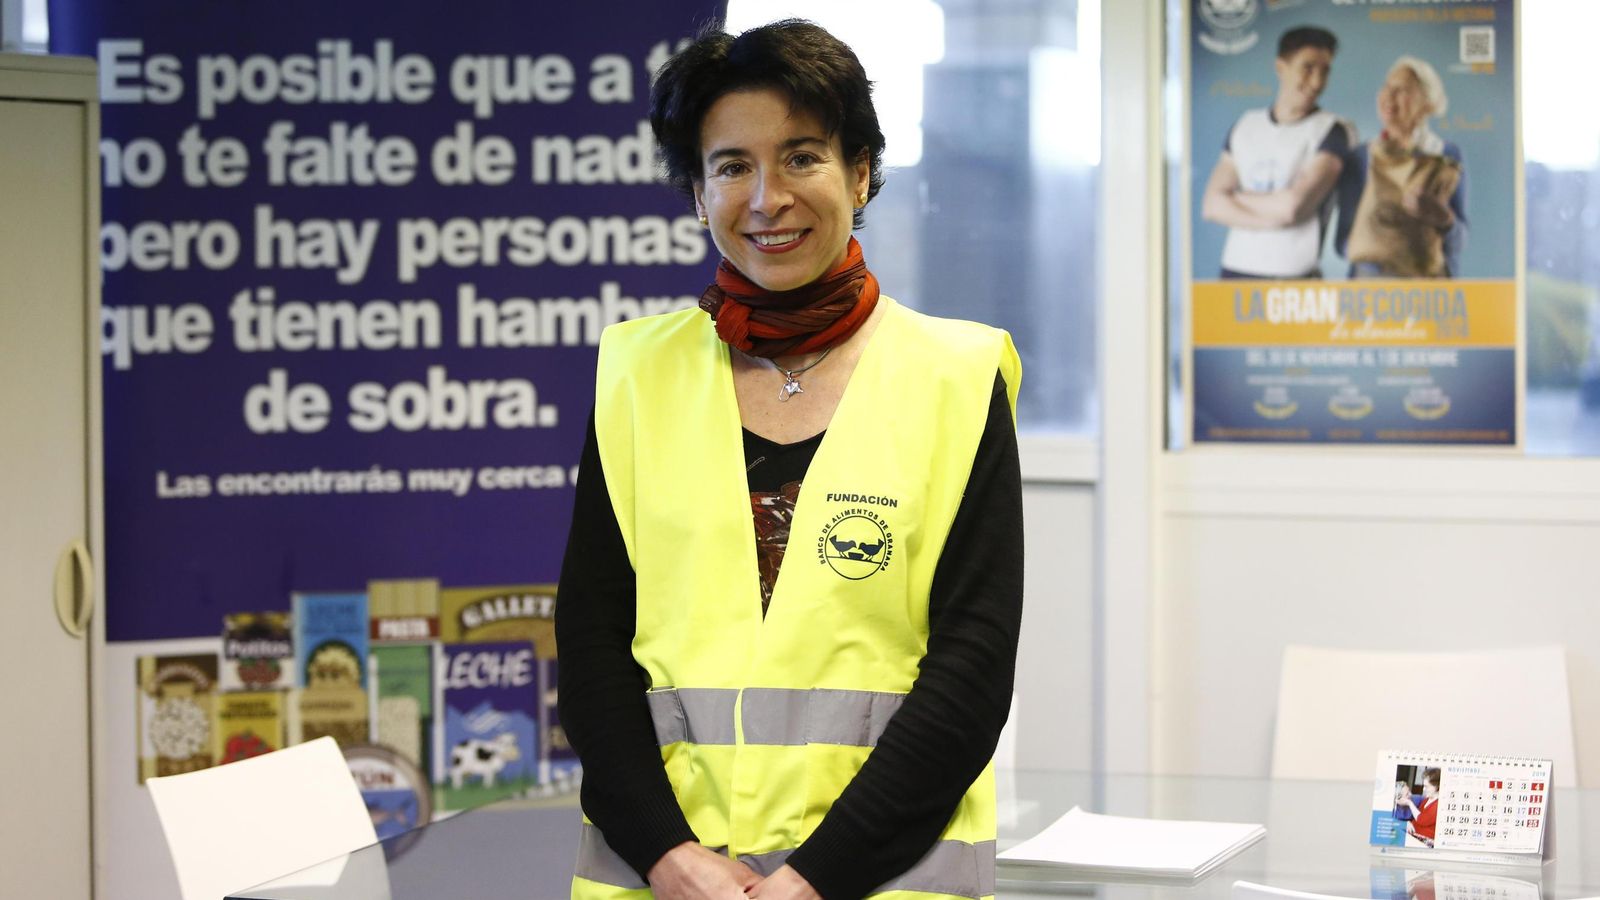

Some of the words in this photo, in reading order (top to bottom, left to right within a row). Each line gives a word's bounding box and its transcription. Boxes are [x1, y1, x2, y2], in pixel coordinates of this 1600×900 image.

[98, 39, 184, 104] Es
[198, 39, 436, 119] posible
[450, 54, 576, 118] que
[589, 54, 633, 103] a
[178, 123, 250, 187] te
[263, 120, 418, 186] falte
[432, 121, 517, 185] de
[100, 220, 240, 284] pero
[255, 204, 380, 284] hay
[398, 214, 708, 283] personas
[101, 303, 214, 370] que
[229, 286, 442, 351] tienen
[457, 281, 698, 347] hamb
[244, 368, 331, 433] de
[348, 365, 558, 431] sobra.
[156, 471, 212, 498] Las
[216, 464, 402, 496] encontrarás
[408, 467, 473, 496] muy
[478, 465, 565, 490] cerca
[826, 494, 898, 507] FUNDACIÓN
[832, 509, 878, 522] ALIMENTOS
[822, 524, 831, 534] DE
[879, 519, 889, 531] DE
[817, 536, 826, 565] BANCO
[880, 532, 893, 572] GRANADA
[460, 595, 556, 627] GALLET
[442, 649, 534, 690] LECHE
